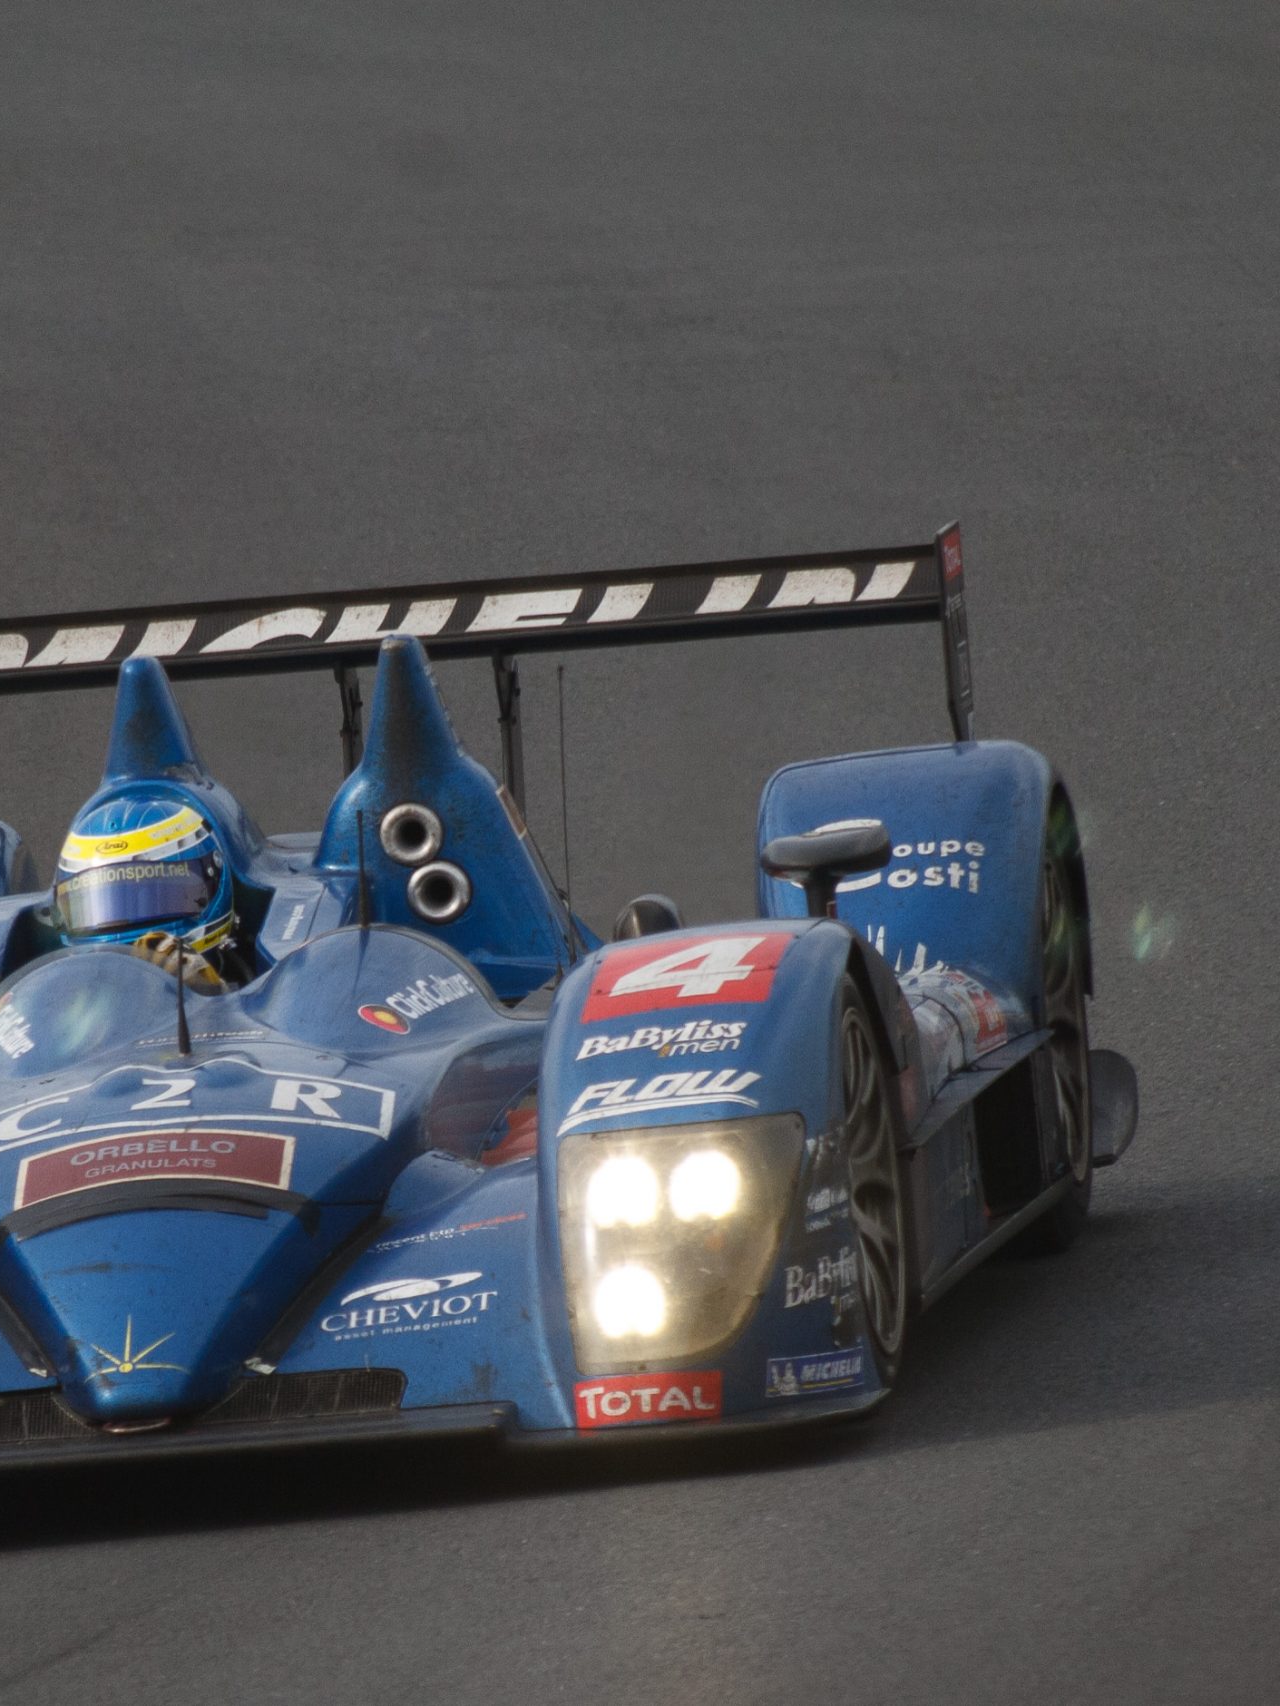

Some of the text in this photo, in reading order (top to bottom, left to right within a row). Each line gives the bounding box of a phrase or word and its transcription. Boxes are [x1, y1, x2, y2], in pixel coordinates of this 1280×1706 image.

[891, 839, 985, 858] oupe
[609, 936, 767, 998] 4
[575, 1020, 747, 1061] BaByliss
[669, 1039, 740, 1057] men
[567, 1069, 762, 1117] FLOW
[70, 1139, 237, 1168] ORBELLO
[84, 1157, 217, 1179] GRANULATS
[321, 1291, 498, 1332] CHEVIOT
[800, 1356, 862, 1382] MICHELIN
[578, 1386, 716, 1419] TOTAL
